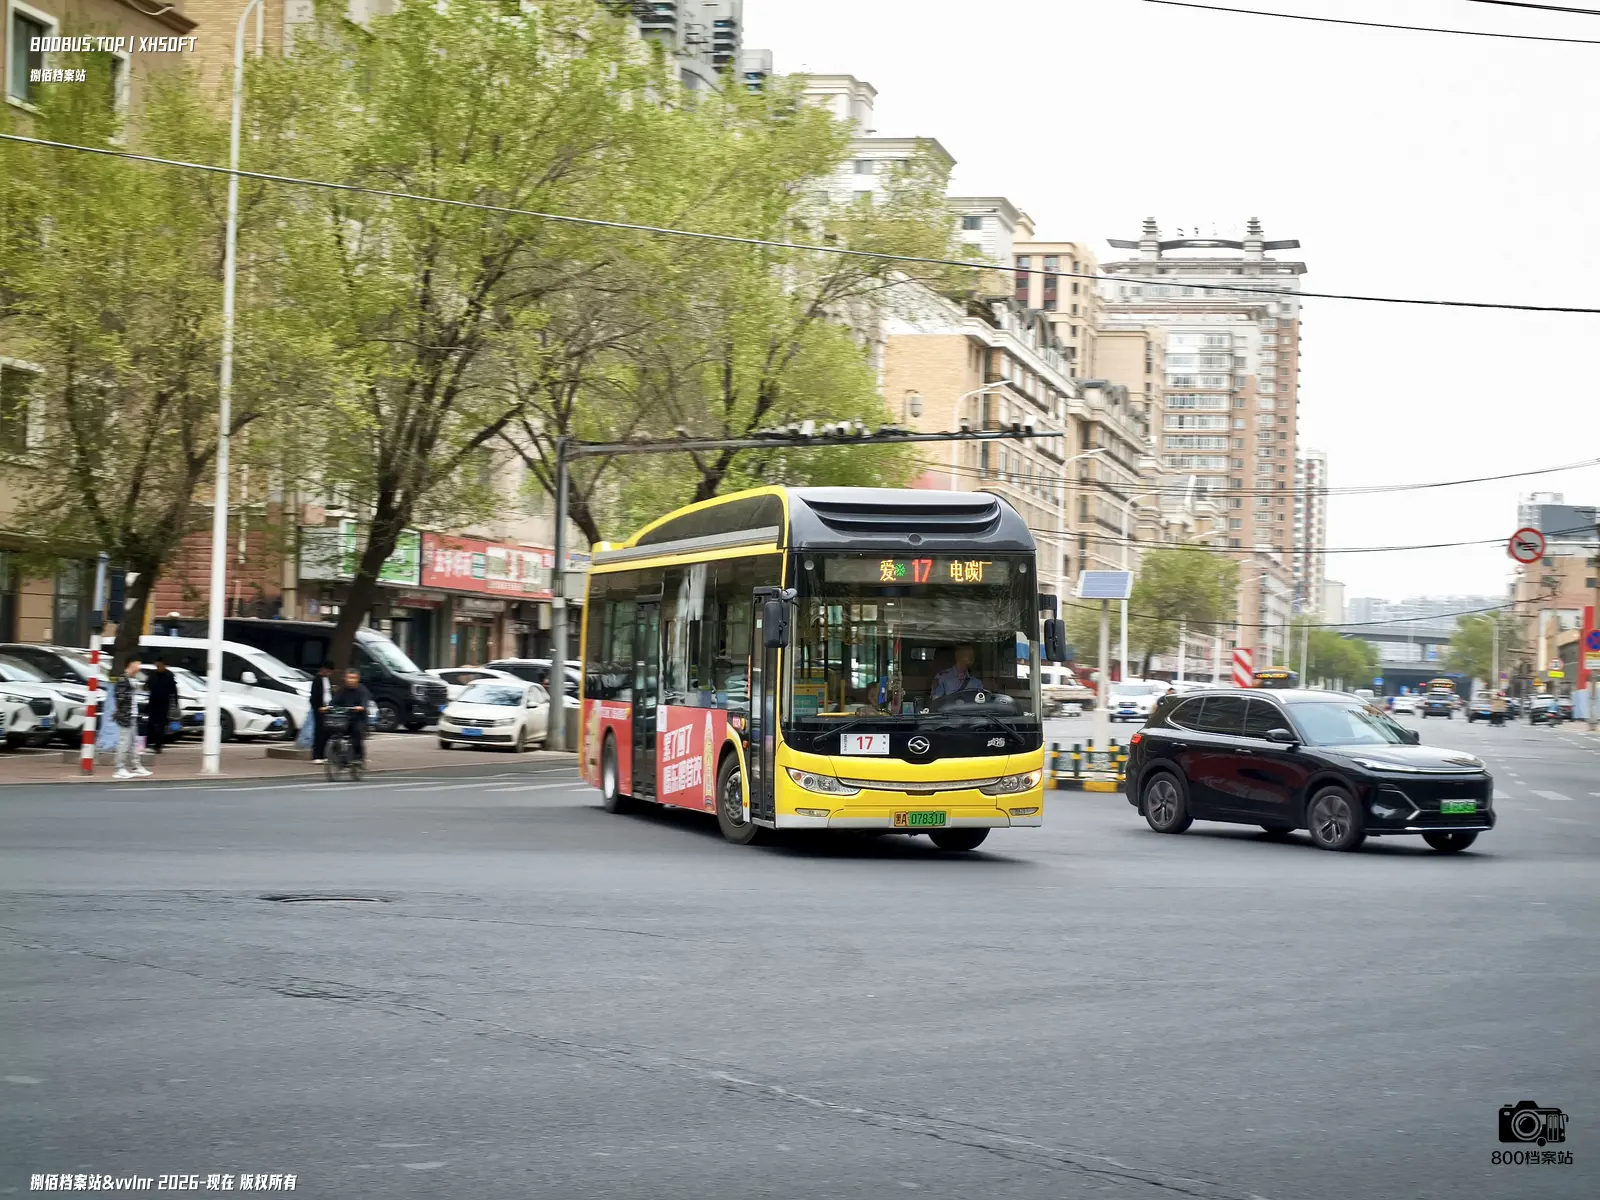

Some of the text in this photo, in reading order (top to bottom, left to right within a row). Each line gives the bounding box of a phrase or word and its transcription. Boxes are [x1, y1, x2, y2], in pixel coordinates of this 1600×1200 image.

[912, 559, 933, 583] 17
[950, 560, 992, 582] 电碳厂
[857, 736, 873, 750] 17
